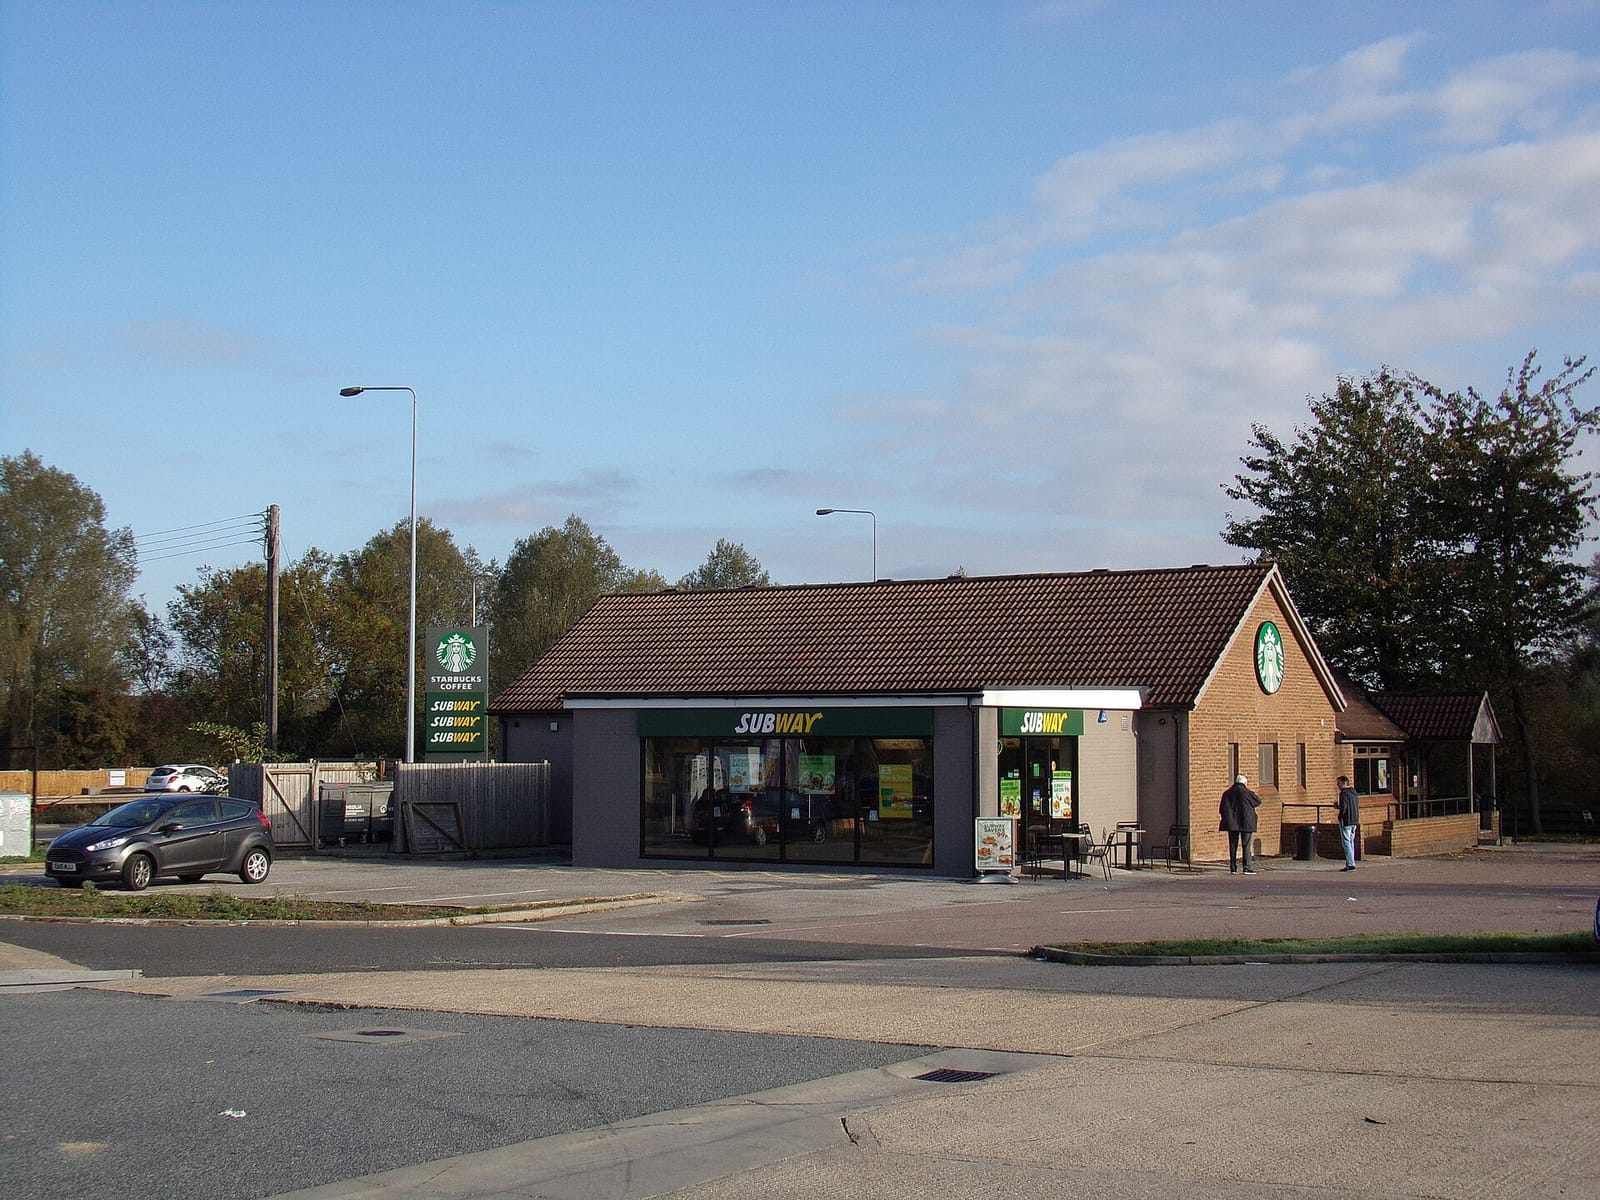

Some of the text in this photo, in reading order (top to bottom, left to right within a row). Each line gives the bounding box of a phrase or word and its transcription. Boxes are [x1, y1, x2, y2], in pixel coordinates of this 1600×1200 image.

[431, 675, 482, 684] STARBUCKS
[430, 700, 481, 711] SUBWAY
[430, 716, 481, 727] SUBWAY
[734, 712, 823, 733] SUBWAY
[1020, 711, 1068, 734] SUBWAY
[430, 732, 481, 743] SUBWAY
